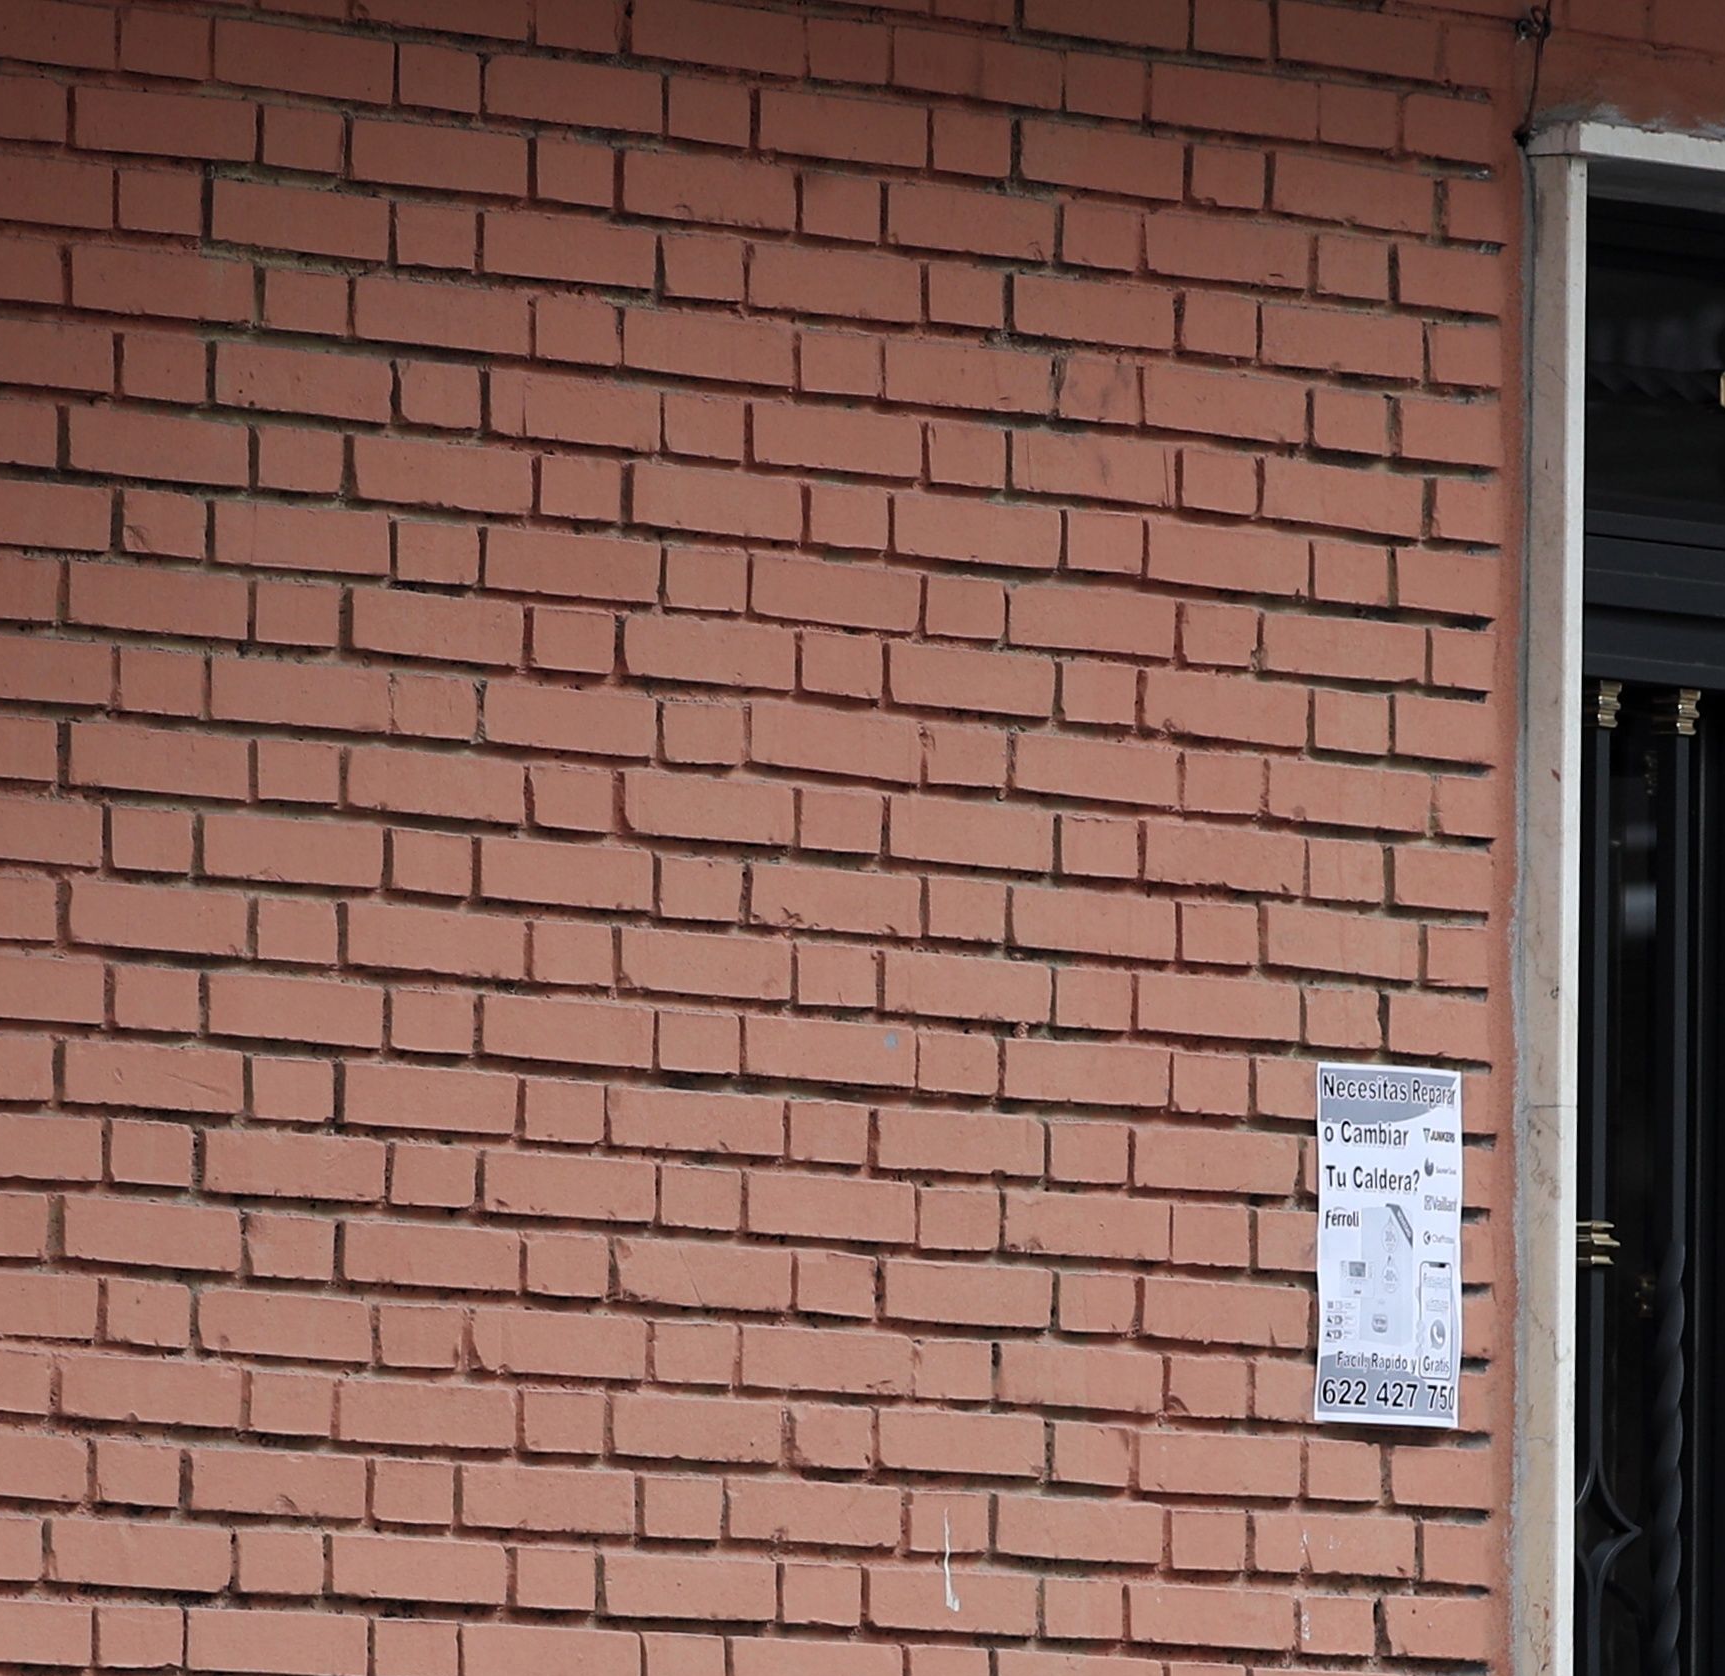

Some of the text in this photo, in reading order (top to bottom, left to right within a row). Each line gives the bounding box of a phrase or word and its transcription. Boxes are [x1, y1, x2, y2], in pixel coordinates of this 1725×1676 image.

[1323, 1074, 1457, 1108] Necesitas Reparar
[1341, 1121, 1409, 1147] Cambiar
[1325, 1165, 1421, 1192] Tu Caldera?
[1423, 1355, 1451, 1374] Gratis
[1322, 1378, 1455, 1411] 622 427 750
